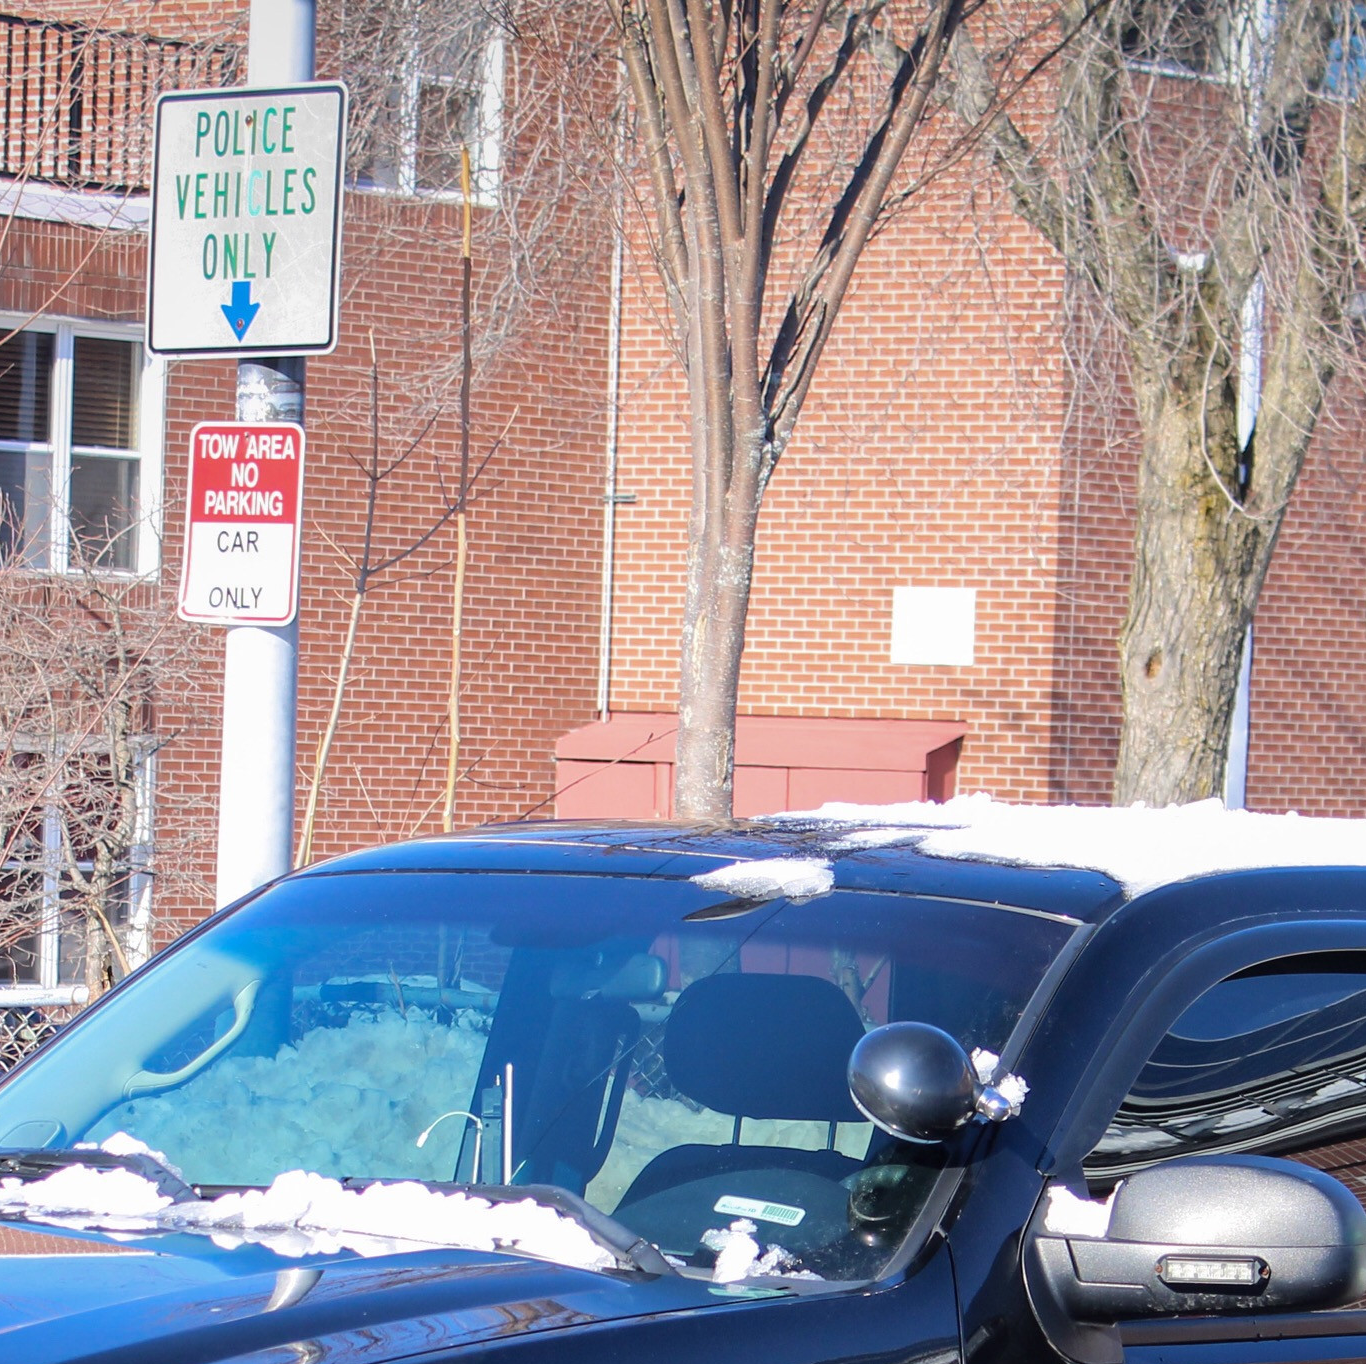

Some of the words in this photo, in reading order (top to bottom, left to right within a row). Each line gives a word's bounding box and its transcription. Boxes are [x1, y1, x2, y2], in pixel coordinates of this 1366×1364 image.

[195, 106, 296, 157] POLICE
[176, 167, 317, 220] VEHICLES
[202, 232, 277, 280] ONLY
[199, 433, 239, 460] TOW
[245, 434, 295, 460] AREA
[231, 462, 259, 488] NO
[204, 490, 283, 517] PARKING
[217, 531, 259, 553] CAR
[209, 586, 263, 609] ONLY
